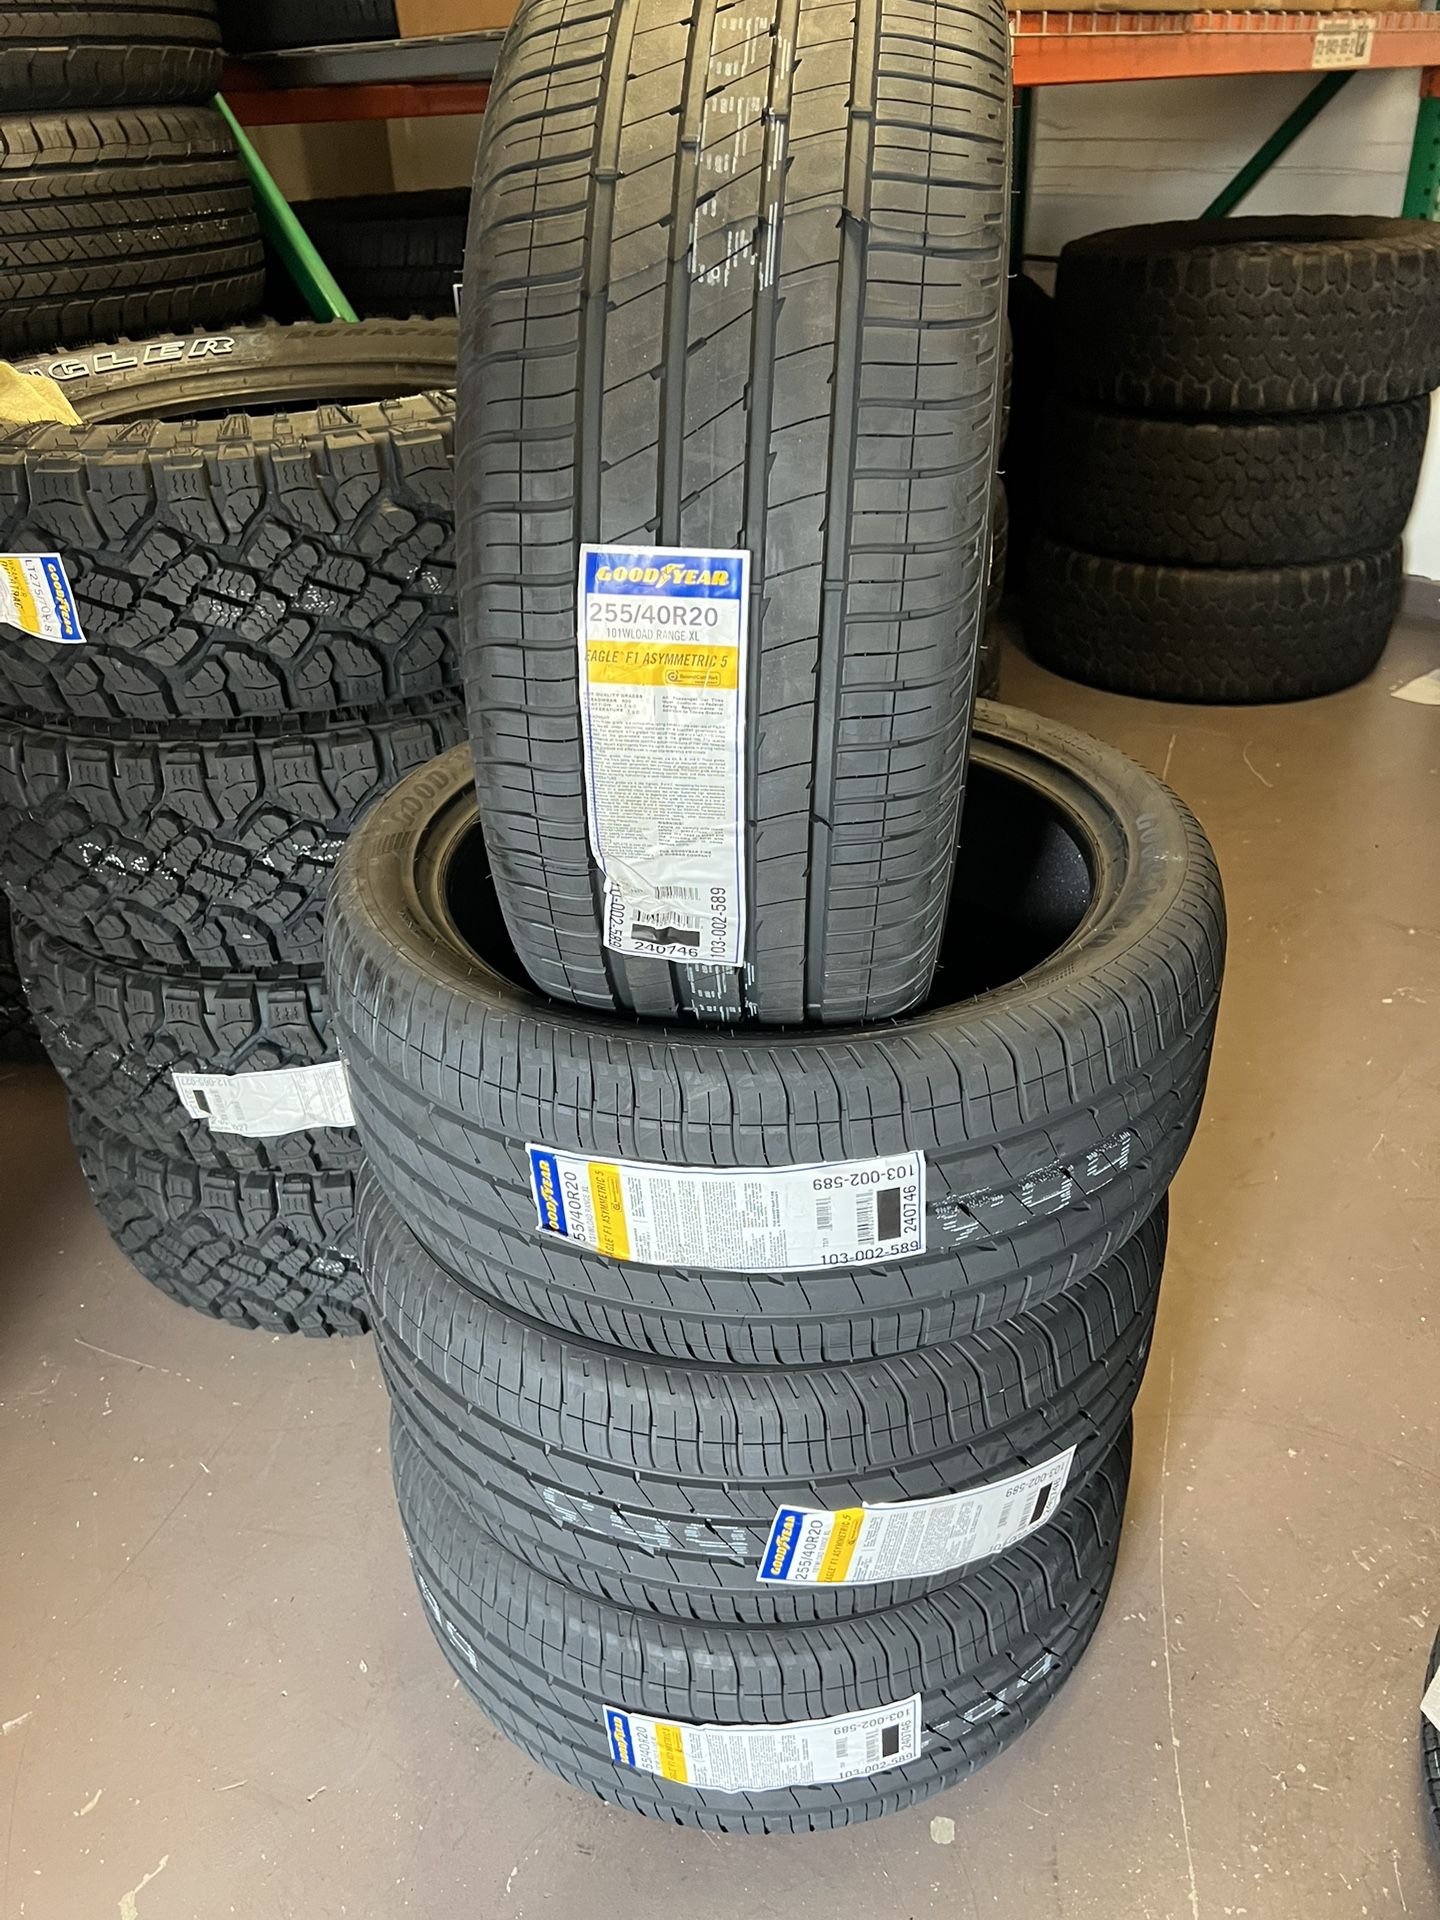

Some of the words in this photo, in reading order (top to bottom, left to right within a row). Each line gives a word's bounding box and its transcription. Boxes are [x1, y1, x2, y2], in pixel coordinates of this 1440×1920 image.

[30, 336, 235, 381] GLER
[595, 563, 729, 588] GOODYEAR
[48, 563, 73, 635] GOODYEAR
[589, 602, 718, 627] 255/40R20
[656, 629, 687, 641] RANGE
[688, 630, 700, 641] XL
[585, 649, 620, 663] EAGLE
[625, 651, 639, 664] F1
[643, 652, 717, 668] ASYMMETRIC
[720, 655, 728, 668] 5
[710, 887, 727, 958] 103-002-589
[634, 941, 698, 957] 240746
[812, 1164, 915, 1191] 103-002-589
[538, 1159, 560, 1230] OODYEAR
[563, 1171, 586, 1242] 55/40R20
[595, 1178, 611, 1225] ASYMMETRIC
[902, 1185, 917, 1234] 240746
[602, 1226, 613, 1236] F1
[602, 1238, 615, 1257] AGLE
[820, 1240, 919, 1266] 103-002-589
[1005, 1461, 1065, 1498] 103-002-589
[770, 1515, 796, 1575] GOODYEAR
[795, 1519, 823, 1580] 255/40R20
[833, 1708, 910, 1736] 103-002-589
[901, 1720, 912, 1751] 240746
[636, 1726, 653, 1770] 55/40R20
[839, 1752, 913, 1779] 103-002-589
